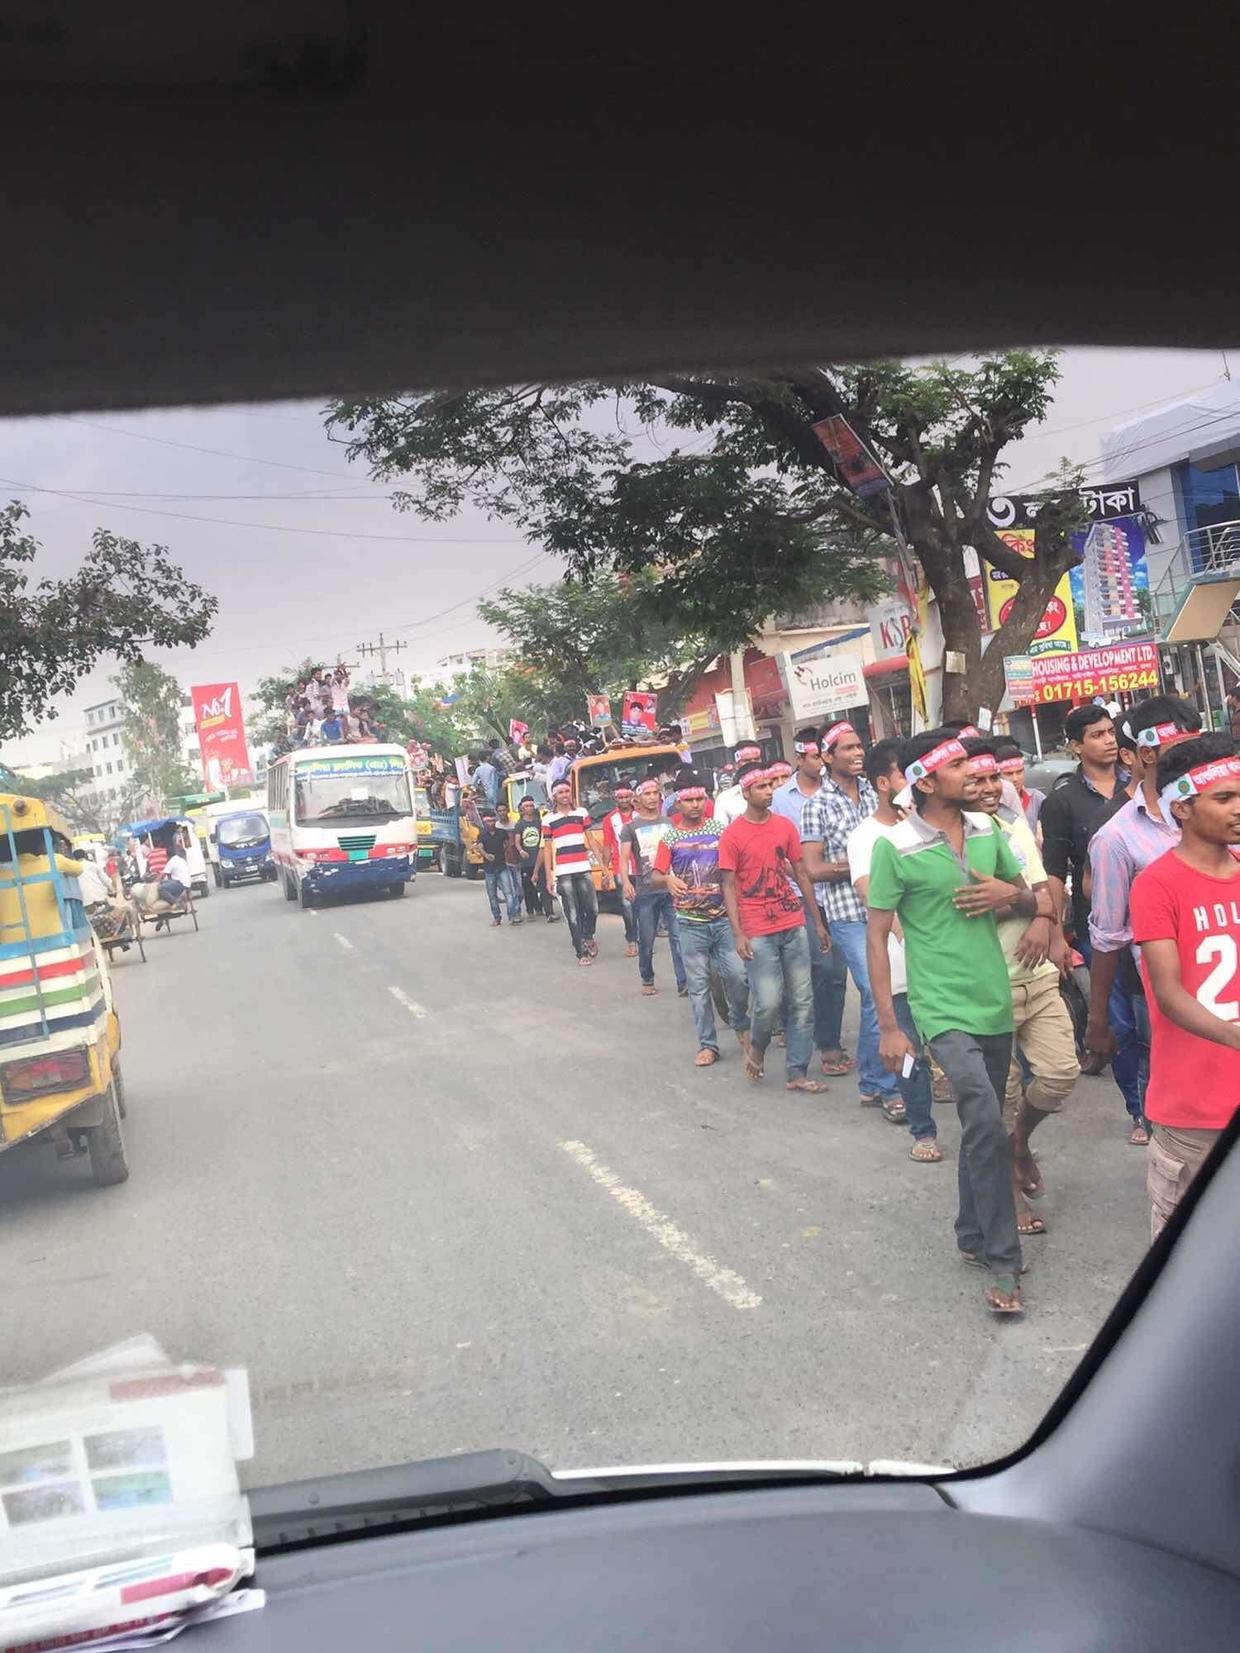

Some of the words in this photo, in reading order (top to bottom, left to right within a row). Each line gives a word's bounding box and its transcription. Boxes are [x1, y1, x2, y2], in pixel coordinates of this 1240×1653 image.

[1032, 658, 1071, 676] HOUSING
[1071, 656, 1078, 671] &
[1078, 648, 1137, 670] DEVELOPMENT
[810, 672, 857, 691] Holcim
[1043, 670, 1159, 700] 01715-156244
